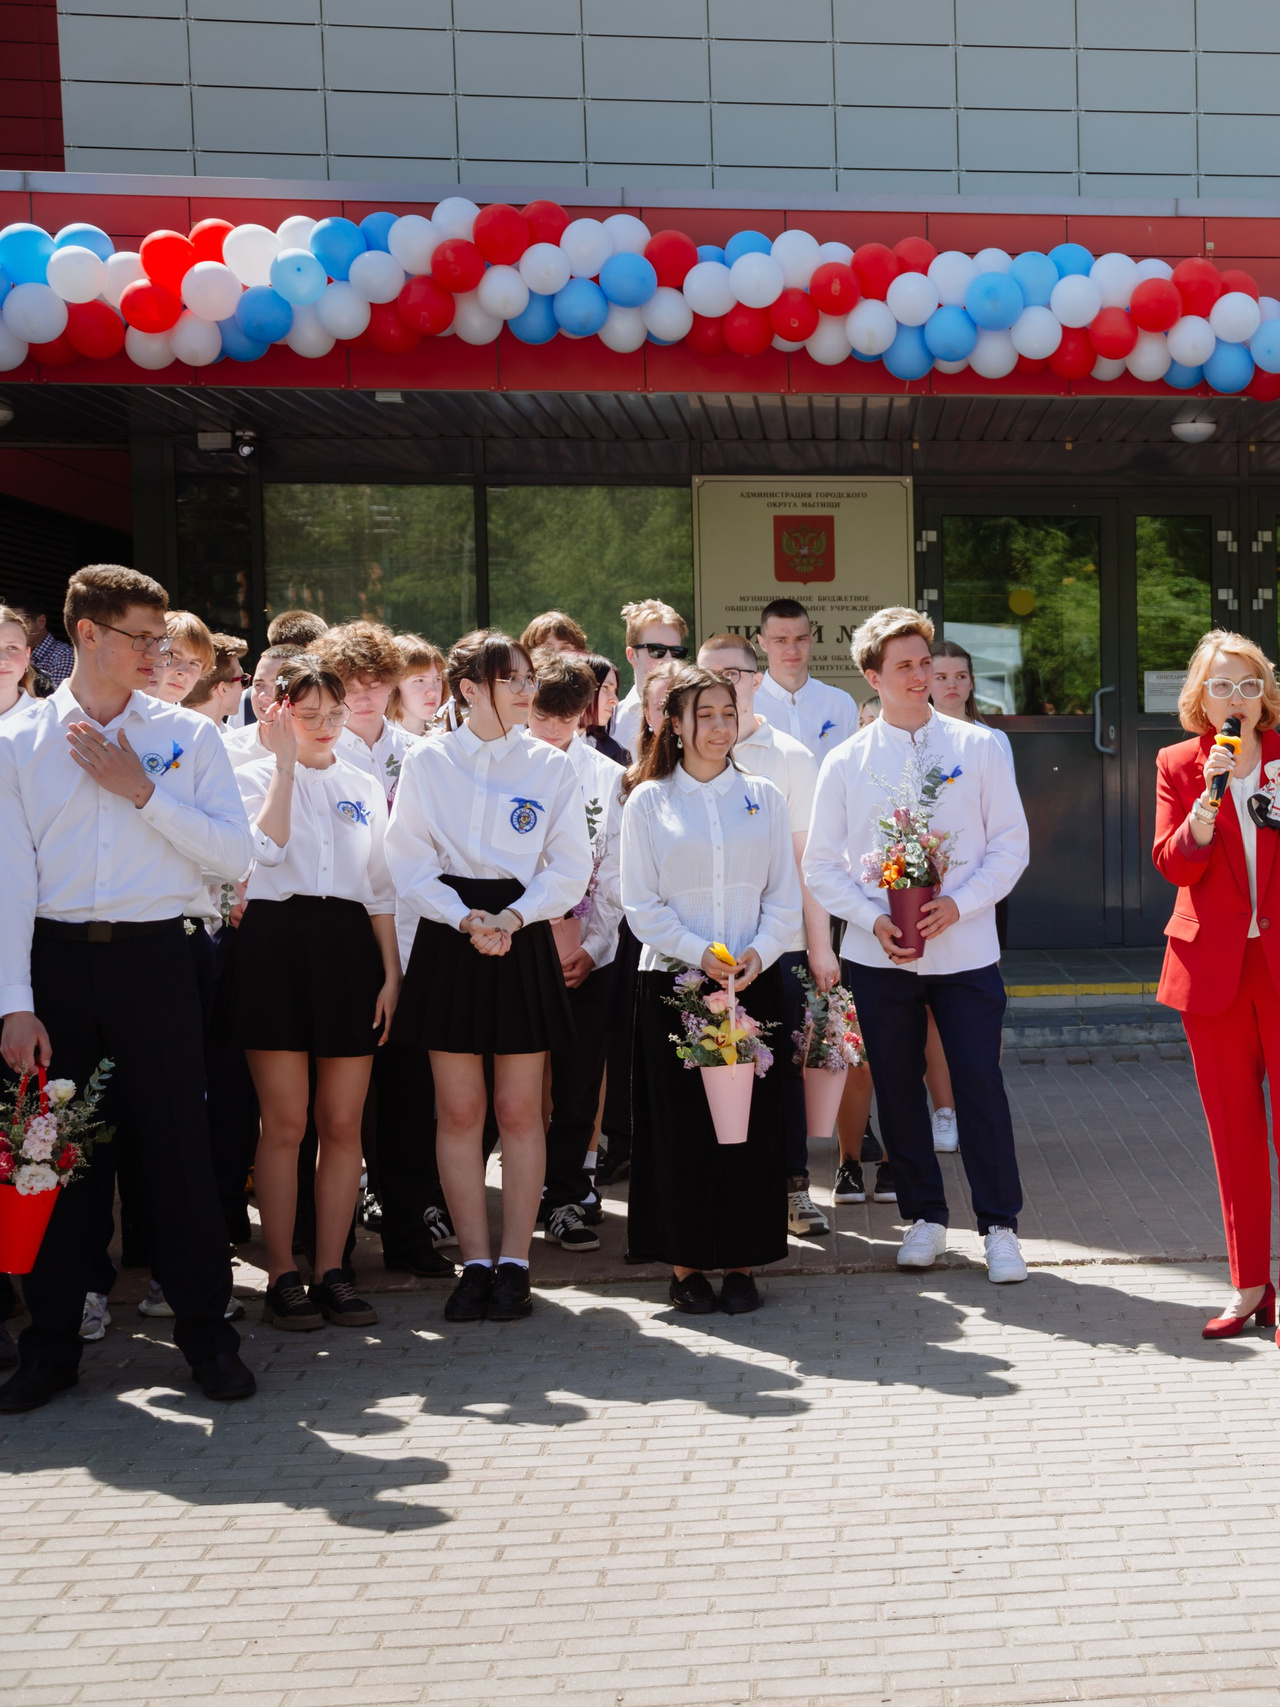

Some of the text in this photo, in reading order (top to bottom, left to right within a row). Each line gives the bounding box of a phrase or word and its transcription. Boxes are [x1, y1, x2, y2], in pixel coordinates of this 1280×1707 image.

[739, 491, 868, 499] АДМИНИСТРАЦИЯ ГОРОДСКОГО
[800, 501, 841, 509] МЫТИЩИ
